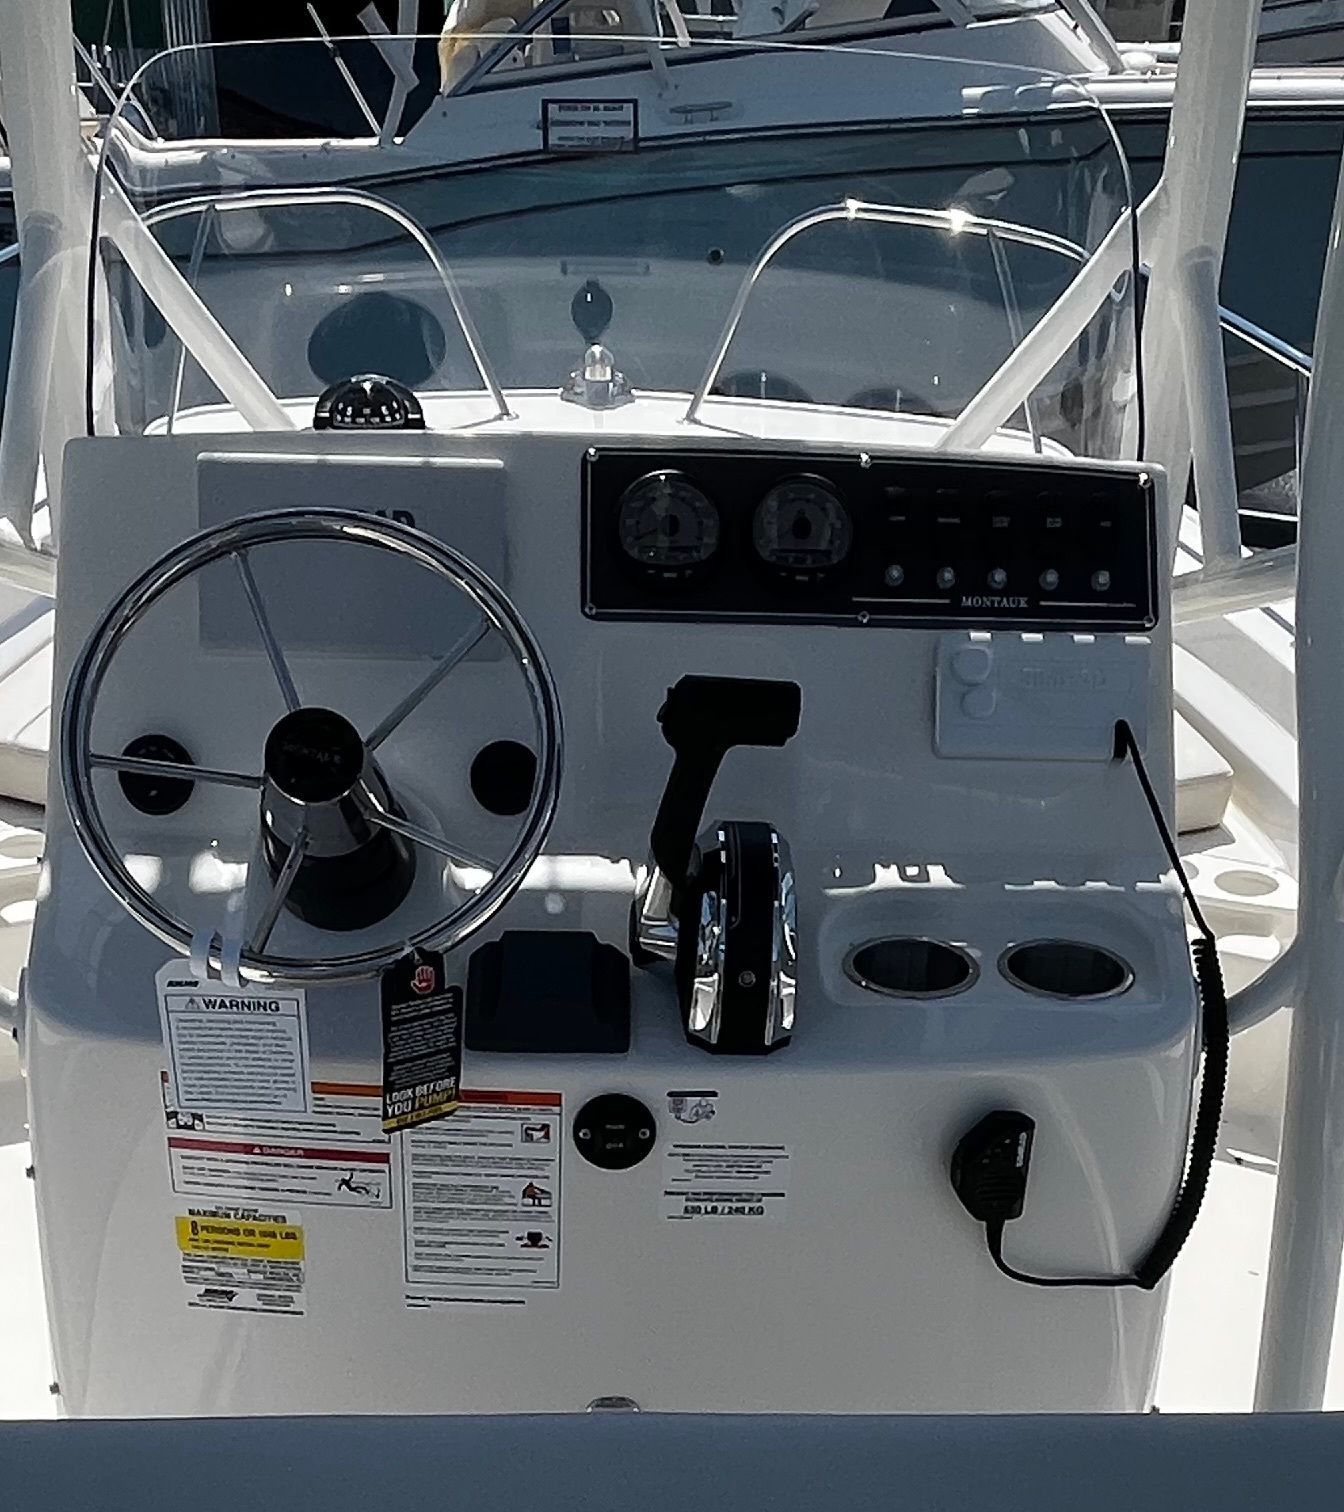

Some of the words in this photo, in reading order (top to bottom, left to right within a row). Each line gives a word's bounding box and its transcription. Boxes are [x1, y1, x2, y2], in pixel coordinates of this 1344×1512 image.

[961, 596, 1030, 609] MONTAUK
[202, 998, 281, 1013] WARNING
[386, 1088, 414, 1105] LOOK
[415, 1077, 457, 1097] BEFORE
[386, 1100, 412, 1118] YOU
[262, 1146, 305, 1157] DANGER
